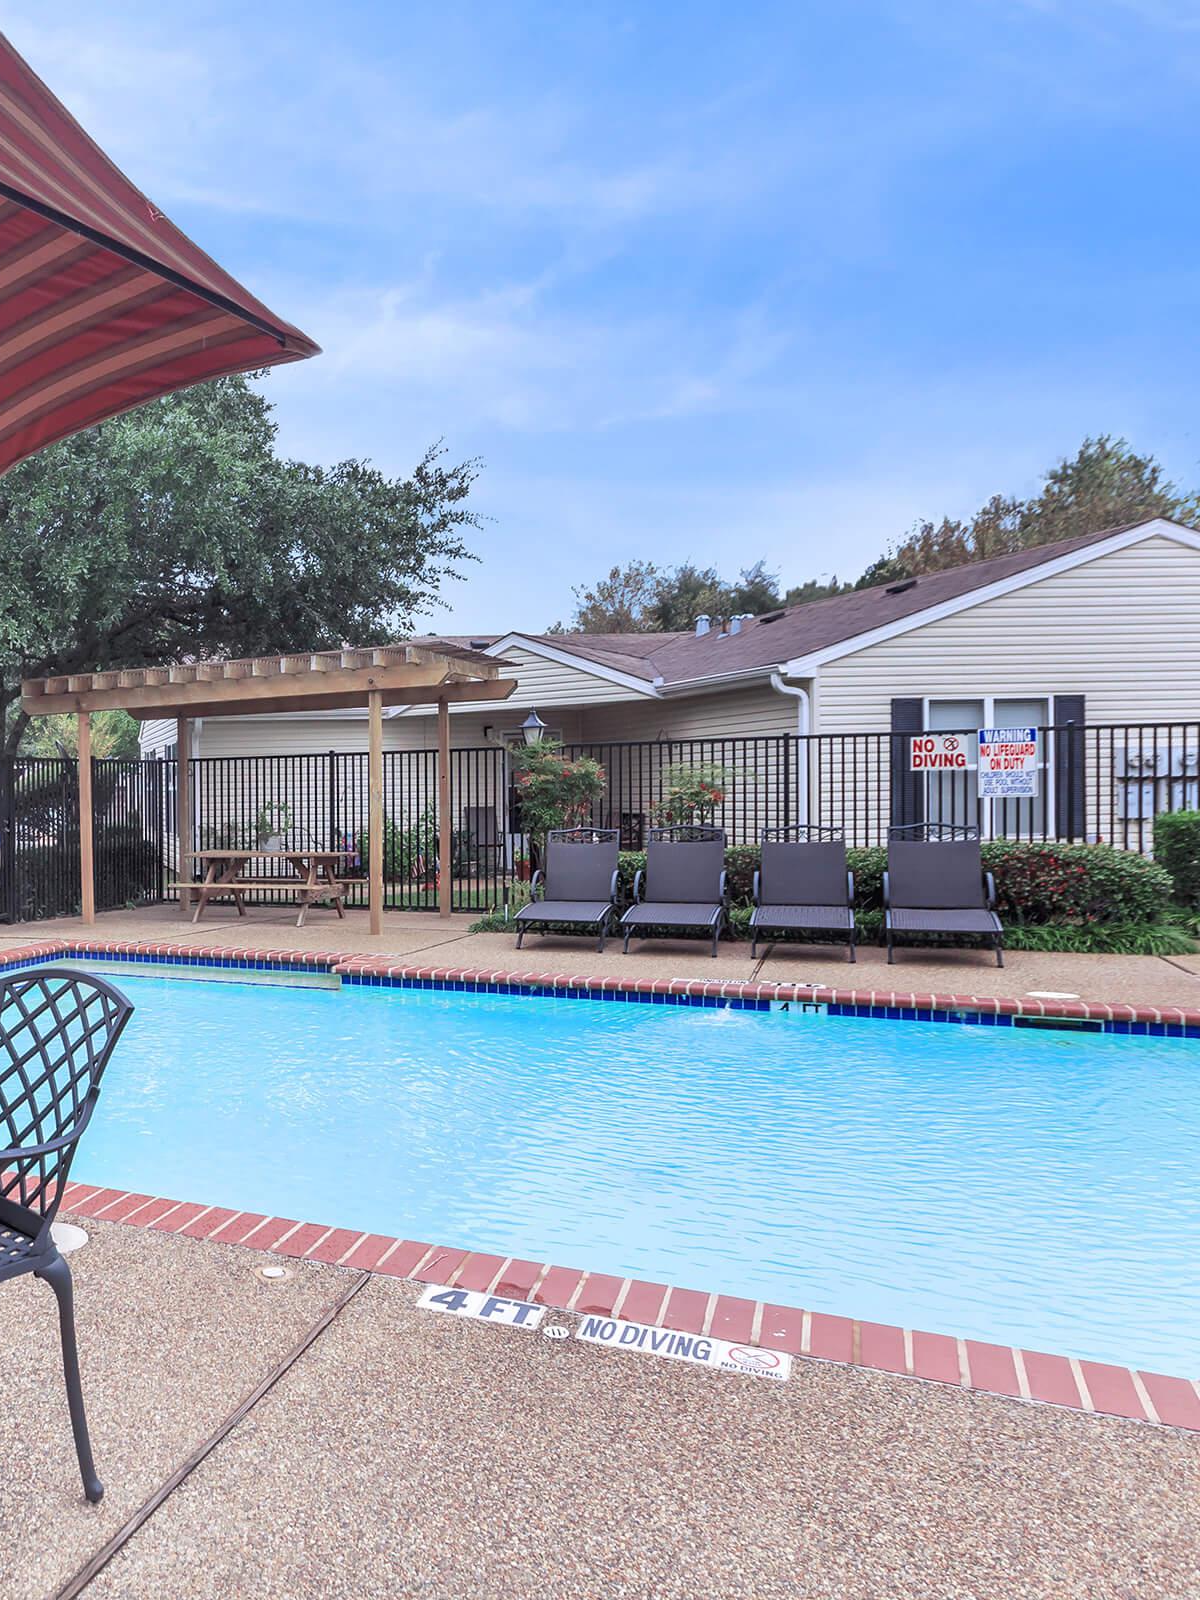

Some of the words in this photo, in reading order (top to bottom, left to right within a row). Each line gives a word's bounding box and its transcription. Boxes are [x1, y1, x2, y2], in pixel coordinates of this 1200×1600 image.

[985, 729, 1031, 743] WARNING
[912, 739, 935, 753] NO
[980, 744, 991, 757] NO
[993, 743, 1035, 757] LIFEGUARD
[912, 753, 966, 768] DIVING
[990, 758, 1002, 770] ON
[1003, 757, 1025, 770] DUTY
[429, 1290, 469, 1311] 4
[479, 1297, 541, 1326] FT.
[582, 1318, 617, 1340] NO
[619, 1325, 713, 1360] DIVING
[720, 1361, 738, 1369] NO
[740, 1365, 783, 1379] DIVING
